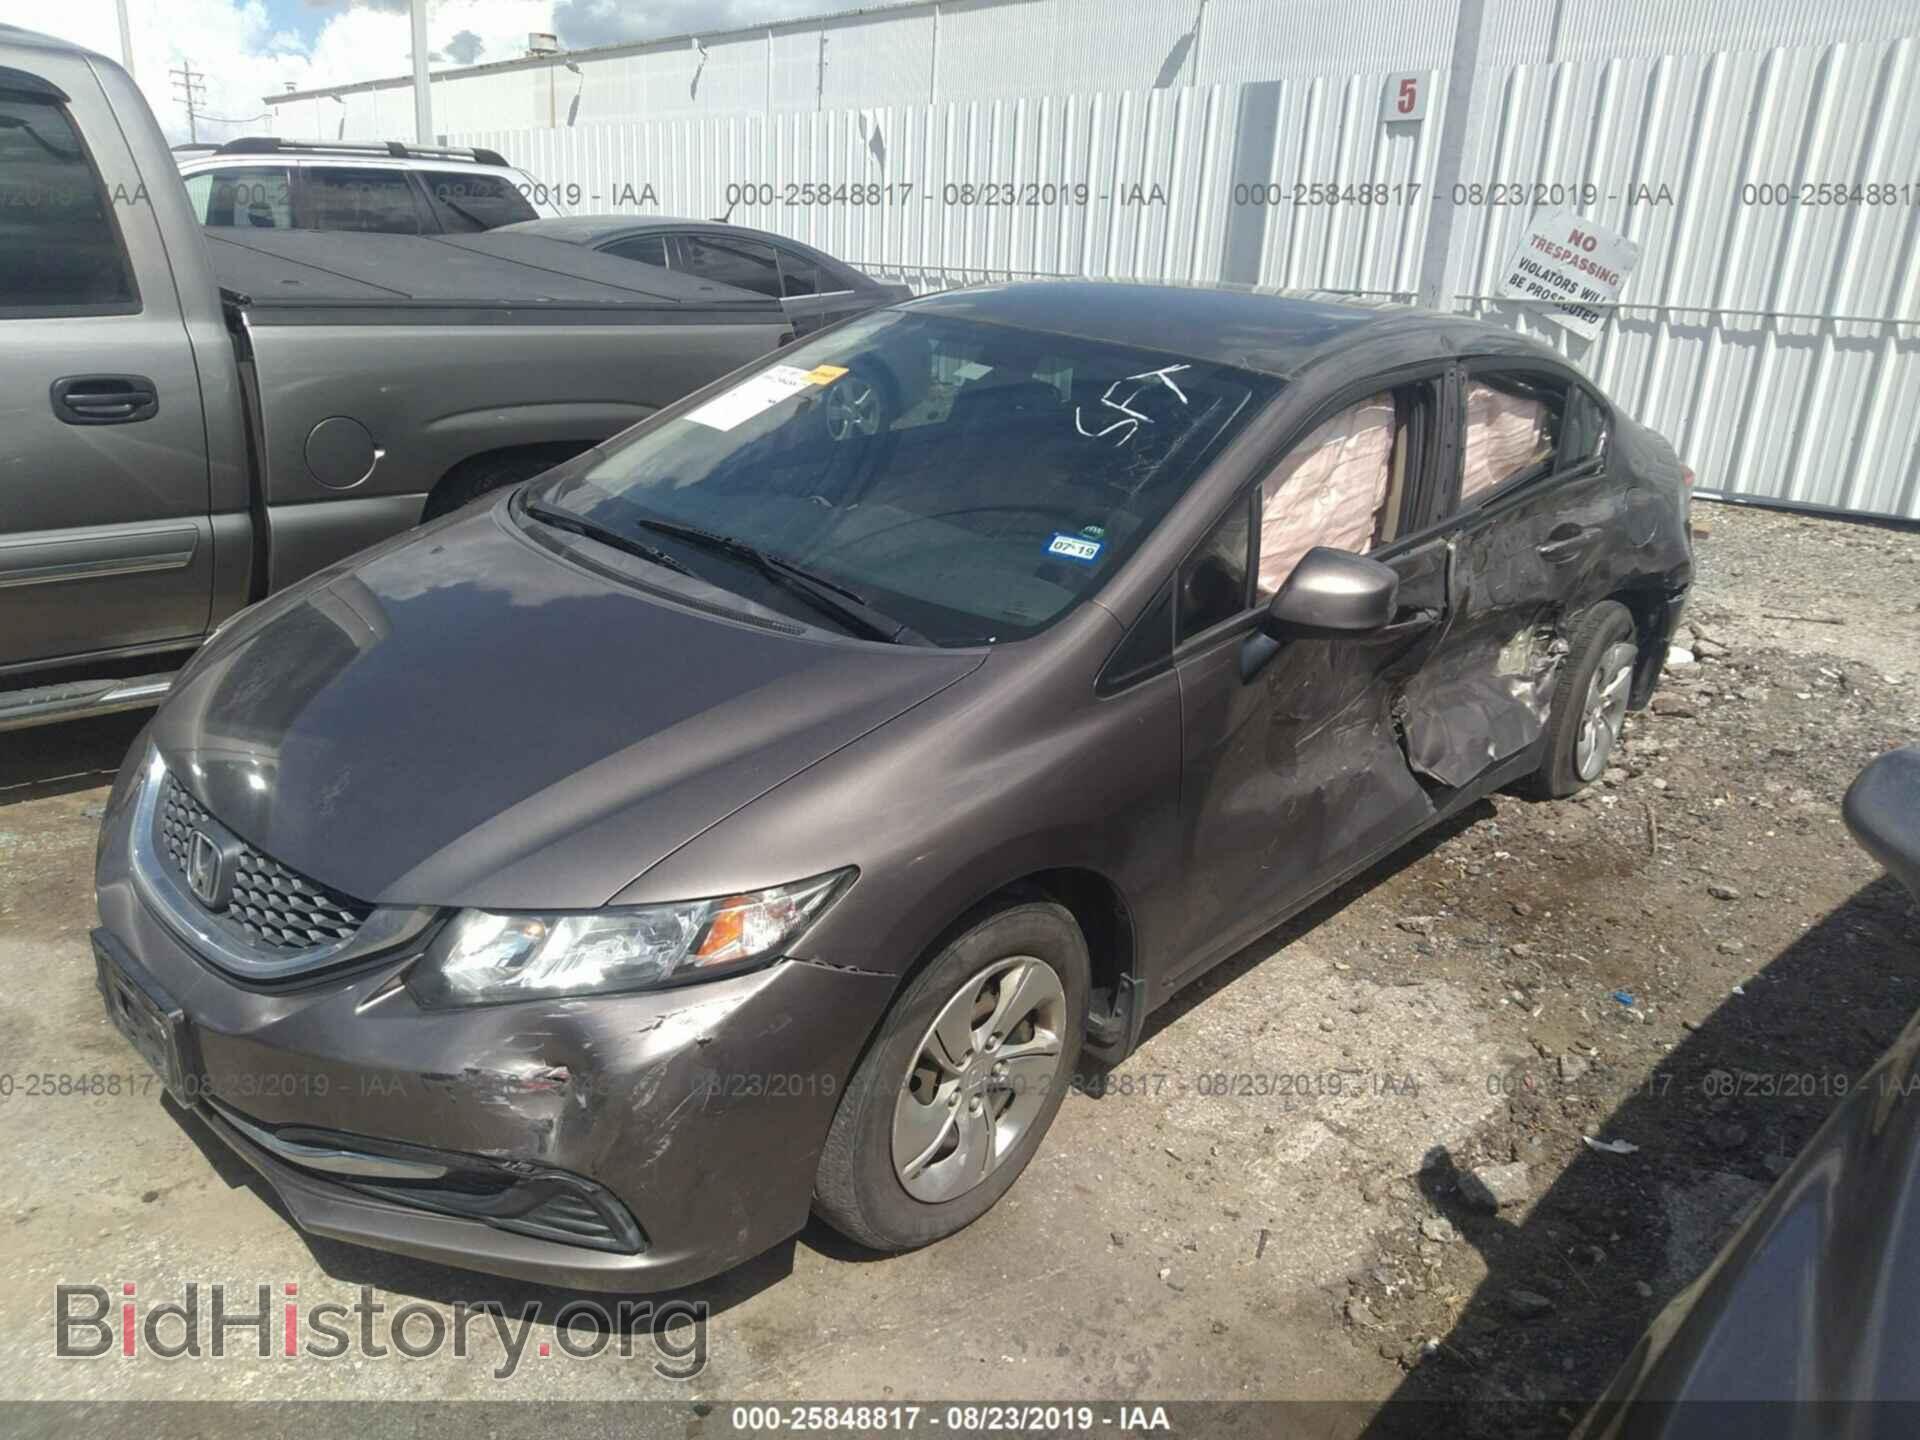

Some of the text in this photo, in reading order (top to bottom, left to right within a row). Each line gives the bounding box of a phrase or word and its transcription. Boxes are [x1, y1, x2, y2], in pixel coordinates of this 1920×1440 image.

[1398, 79, 1417, 114] 5
[1567, 229, 1598, 252] NO
[1518, 256, 1579, 294] VIOLATORS
[1529, 234, 1620, 287] TRESPASSING
[1508, 273, 1600, 325] BE PROSECUTED
